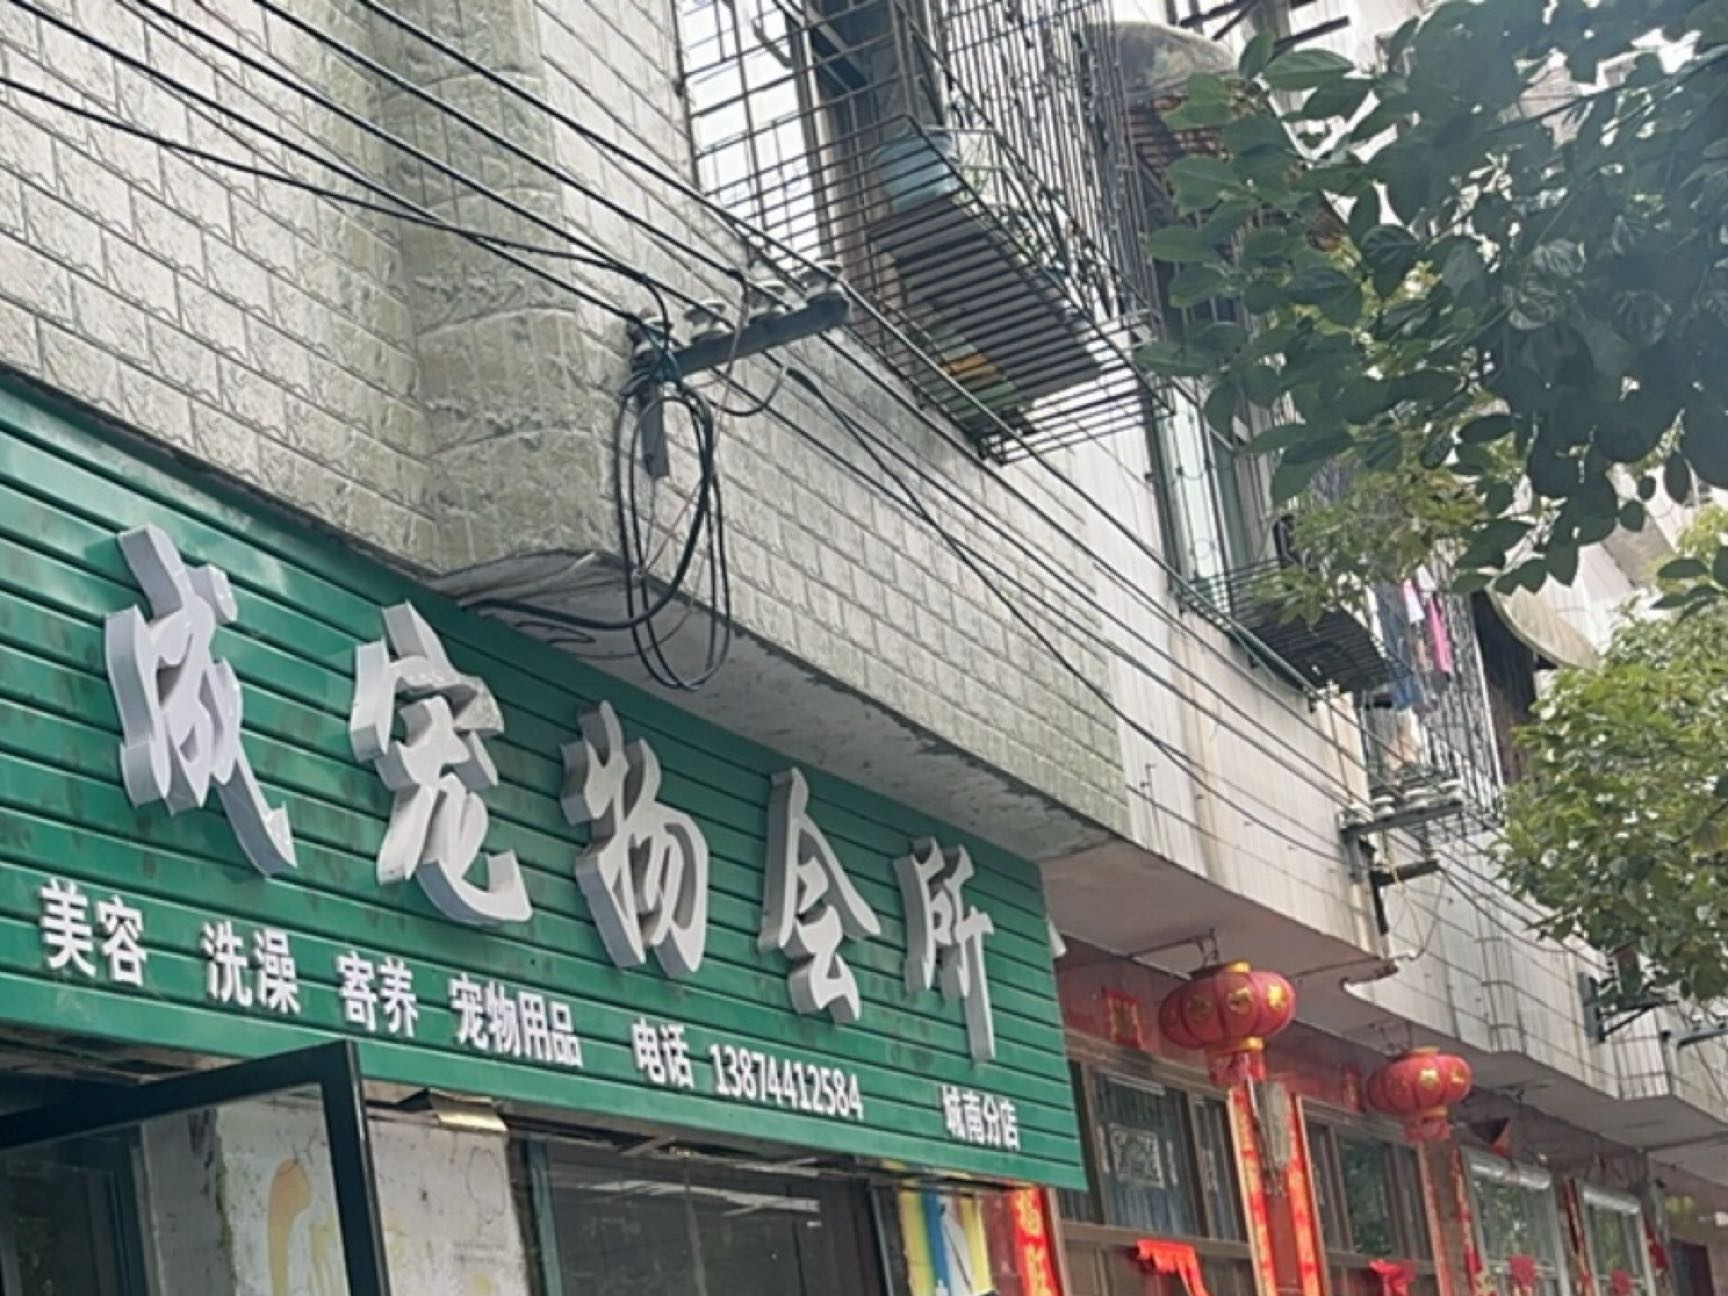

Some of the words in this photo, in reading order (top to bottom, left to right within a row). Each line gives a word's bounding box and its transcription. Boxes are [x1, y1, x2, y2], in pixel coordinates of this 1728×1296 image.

[38, 877, 147, 988] 美容
[200, 919, 301, 1015] 洗澡
[336, 950, 419, 1038] 寄养
[448, 971, 583, 1068] 宠物用品
[632, 1017, 694, 1089] 电话
[708, 1043, 865, 1121] 13874412584
